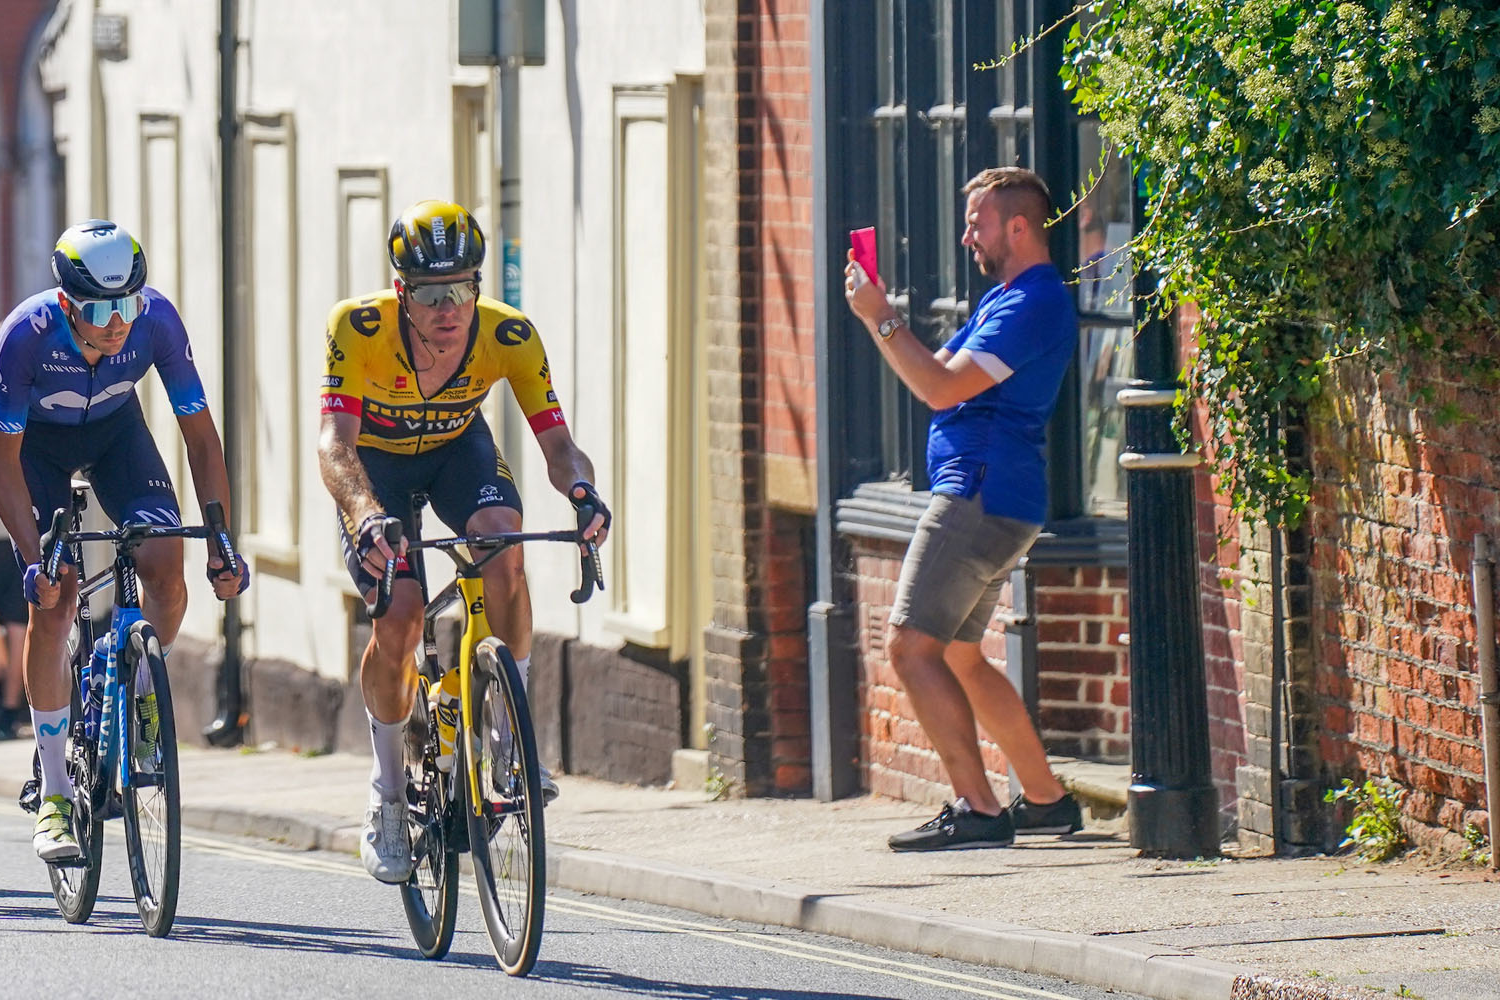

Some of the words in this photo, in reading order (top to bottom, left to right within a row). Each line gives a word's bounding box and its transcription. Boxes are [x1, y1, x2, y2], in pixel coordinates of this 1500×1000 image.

[431, 216, 446, 246] STEVEN
[110, 350, 137, 365] GOBIK
[42, 362, 87, 373] CANYON
[405, 411, 475, 431] VISMA
[477, 495, 503, 505] AGU
